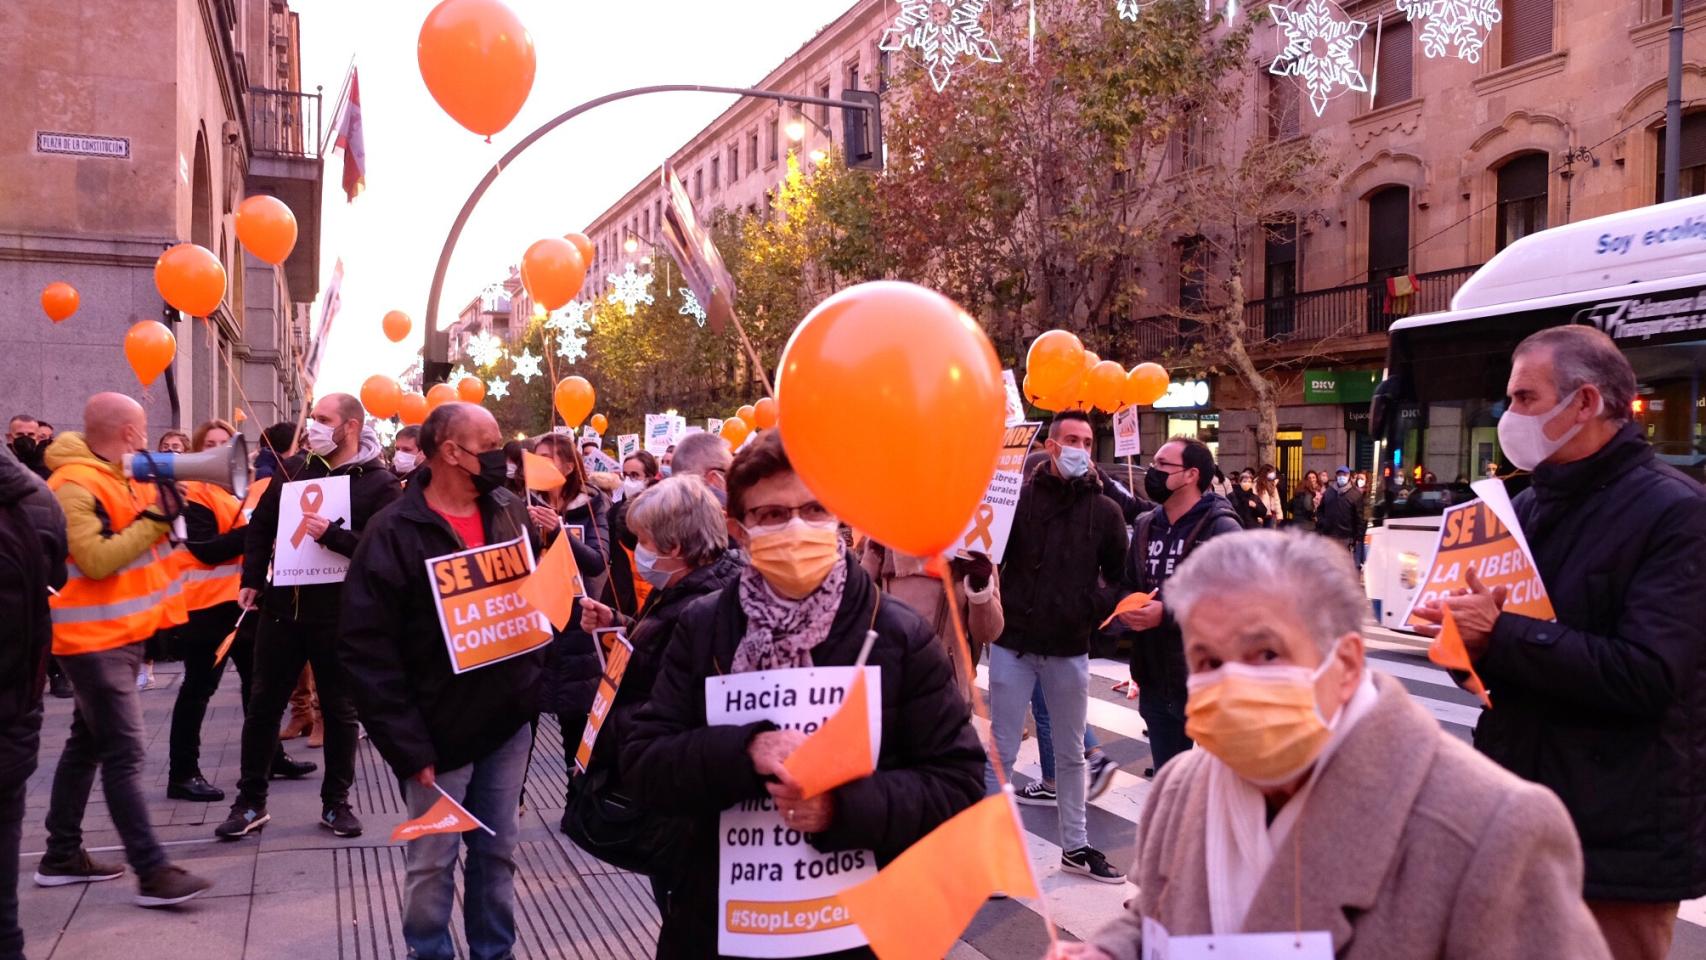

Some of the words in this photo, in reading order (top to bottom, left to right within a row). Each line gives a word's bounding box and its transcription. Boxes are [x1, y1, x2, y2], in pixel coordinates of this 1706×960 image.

[43, 136, 61, 149] PLAZA
[64, 139, 71, 149] DE
[73, 139, 80, 150] LA
[1596, 233, 1636, 255] Soy
[1311, 381, 1336, 390] DKV
[1003, 426, 1038, 447] NDE
[988, 483, 1017, 496] lurales
[992, 472, 1018, 485] ibres
[1441, 506, 1477, 548] SE
[1484, 503, 1510, 539] V
[282, 568, 304, 576] STOP
[306, 567, 321, 576] LEY
[434, 556, 474, 595] SE
[1432, 561, 1461, 584] LA
[453, 602, 481, 626] LA
[484, 592, 528, 618] ESCU
[452, 610, 541, 653] CONCERT
[725, 684, 797, 713] Hacia
[809, 685, 845, 706] un
[726, 826, 765, 847] con
[730, 861, 783, 885] para
[794, 850, 865, 881] todos
[731, 904, 850, 932] #StopLeyCel
